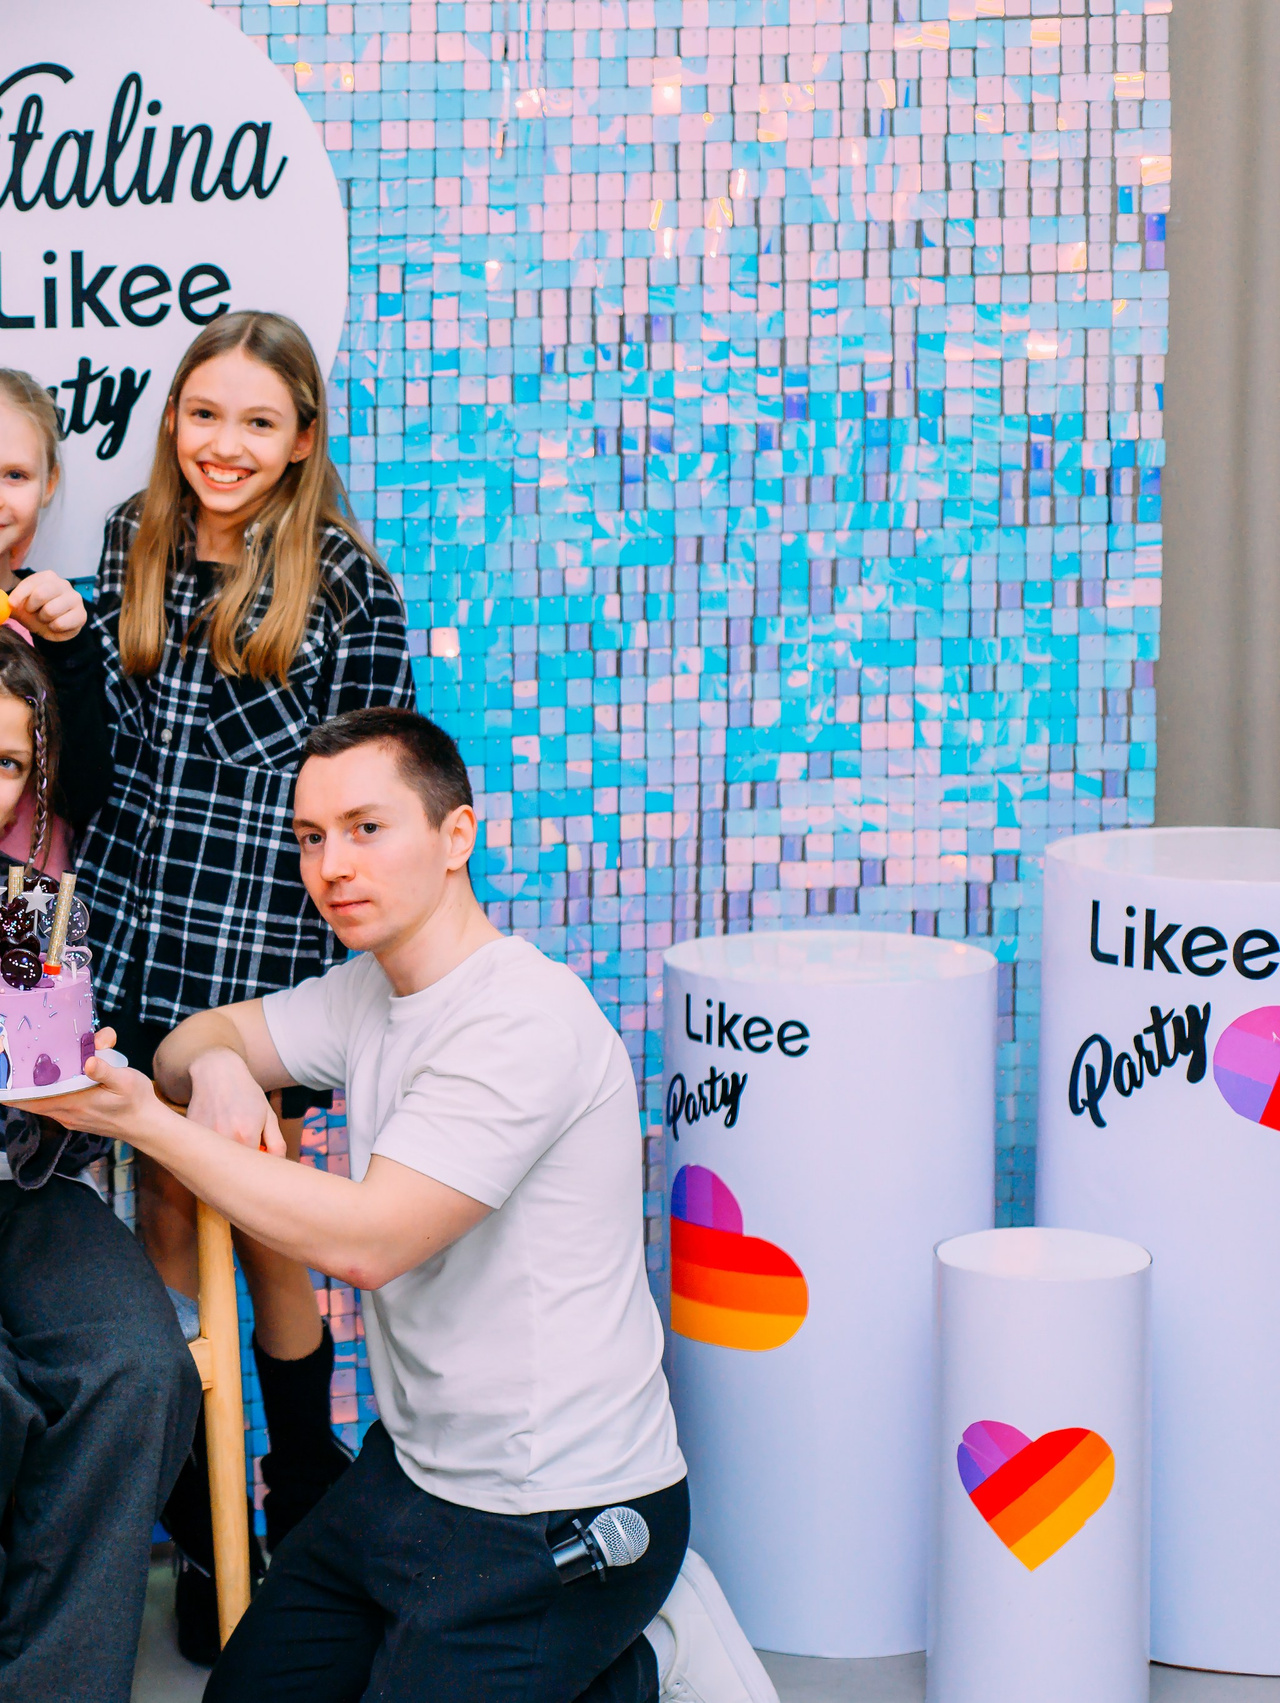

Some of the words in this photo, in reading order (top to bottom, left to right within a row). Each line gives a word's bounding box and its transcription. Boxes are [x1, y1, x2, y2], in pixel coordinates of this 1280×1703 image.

[1090, 899, 1280, 981] Likee
[685, 992, 810, 1058] Likee
[666, 1065, 748, 1142] Party
[1068, 1001, 1211, 1129] Party
